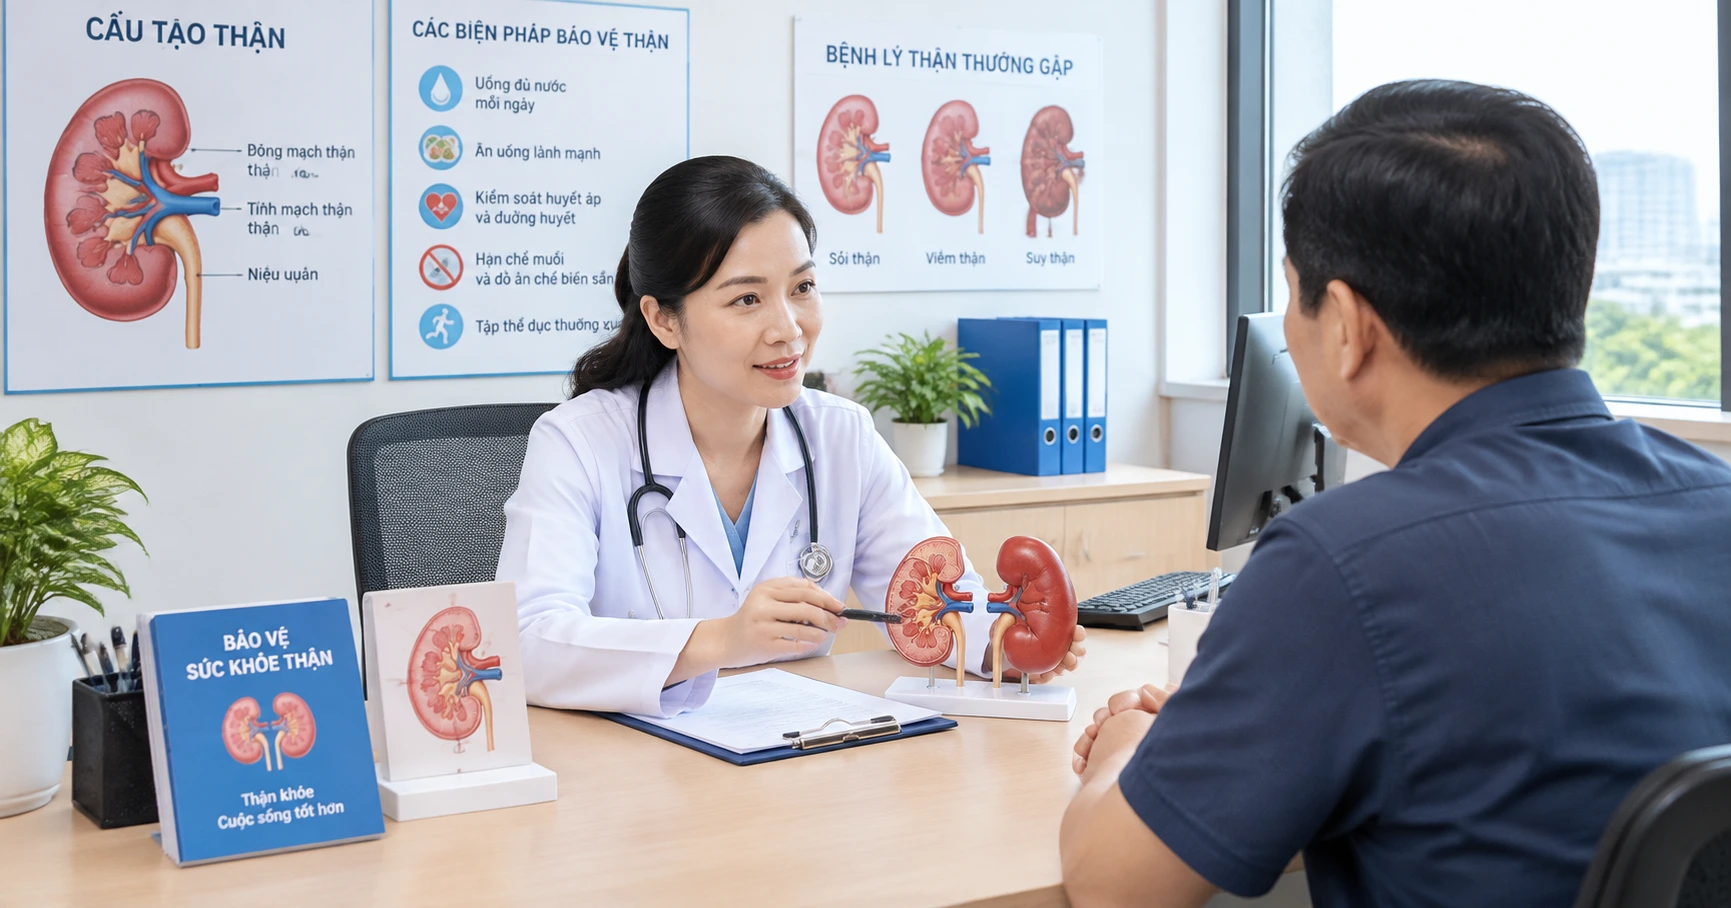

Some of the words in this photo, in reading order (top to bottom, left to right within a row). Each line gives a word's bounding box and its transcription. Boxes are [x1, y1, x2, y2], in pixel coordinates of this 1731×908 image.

[86, 10, 143, 43] CẤU
[151, 18, 206, 50] TẠO
[213, 20, 285, 54] THẬN
[412, 16, 450, 38] CÁC
[503, 22, 552, 45] PHÁP
[826, 41, 877, 69] BỆNH
[883, 44, 903, 67] LÝ
[908, 46, 957, 73] THẬN
[534, 79, 567, 93] nước
[286, 144, 323, 161] mạch
[565, 146, 601, 163] mạnh
[513, 191, 542, 205] soát
[280, 201, 319, 219] mạch
[527, 319, 552, 335] dục
[186, 658, 225, 680] SỨC
[283, 648, 333, 671] THẬN
